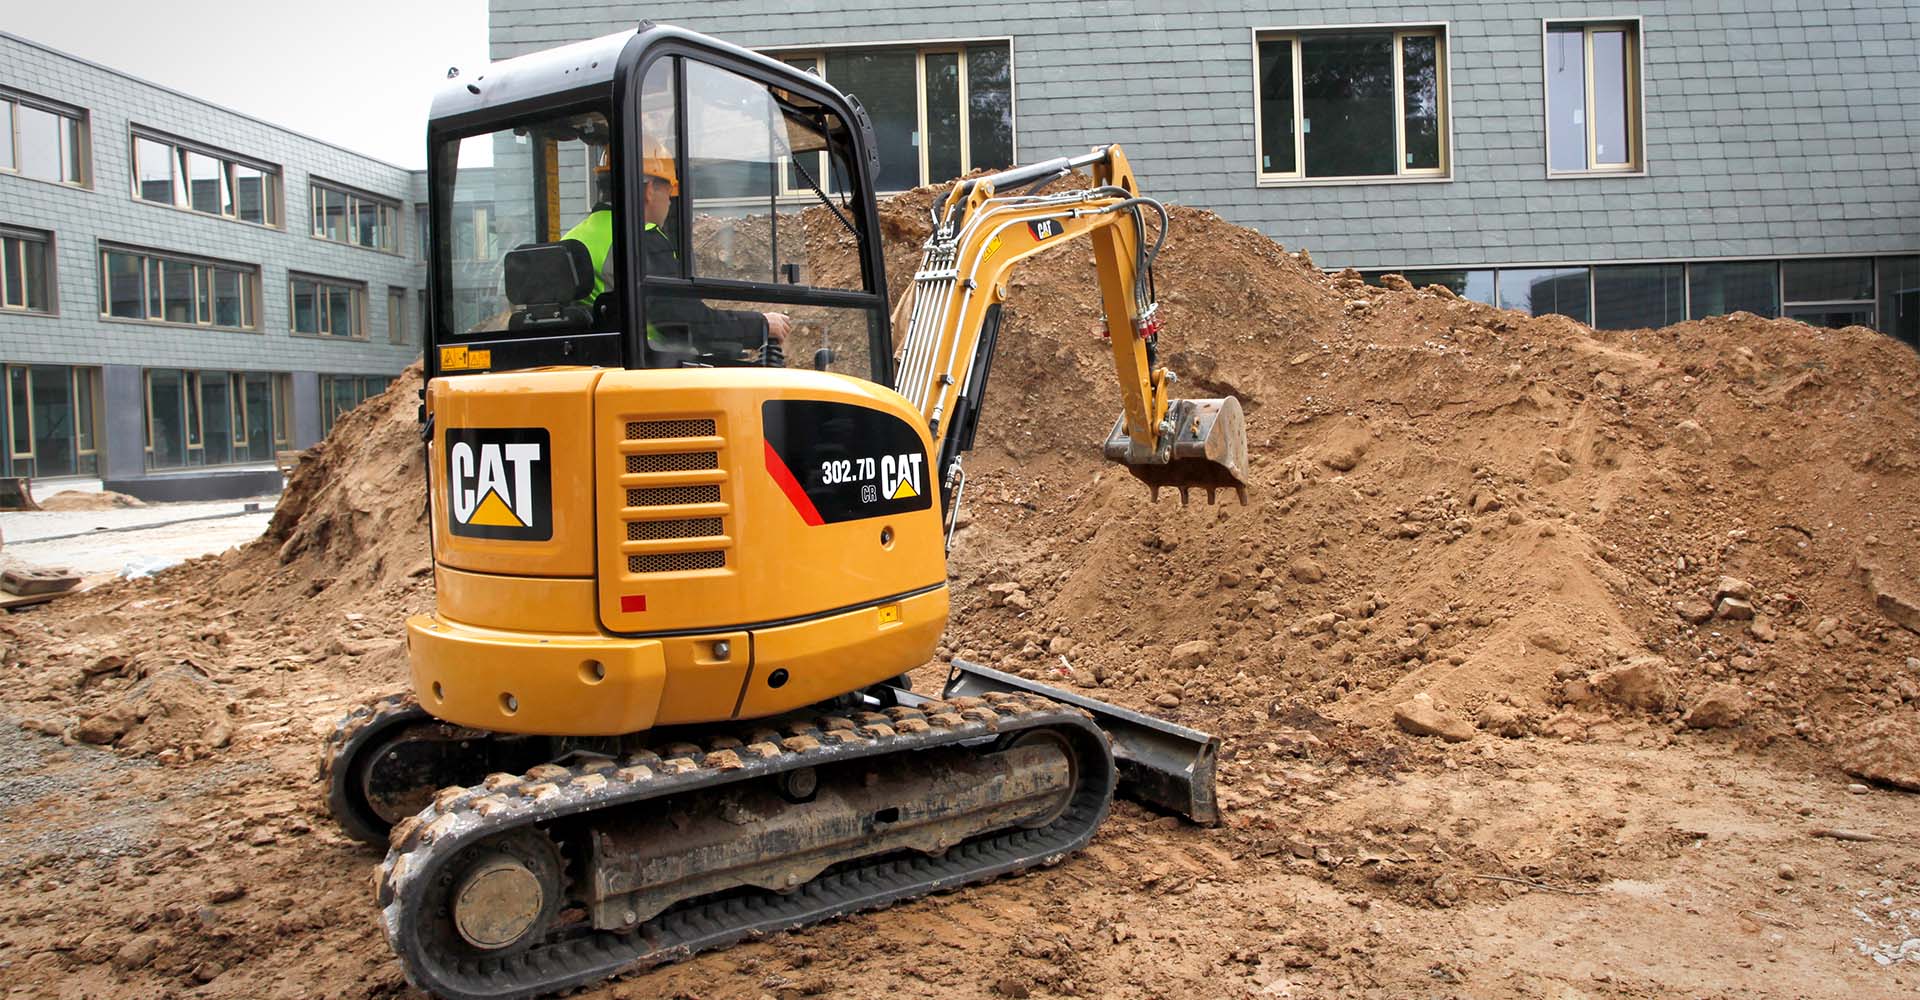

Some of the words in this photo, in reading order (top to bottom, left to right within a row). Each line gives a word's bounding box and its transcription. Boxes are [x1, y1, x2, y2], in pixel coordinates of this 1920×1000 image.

[1037, 220, 1052, 240] CAT
[452, 442, 540, 527] CAT
[821, 457, 876, 485] 302.7D
[881, 453, 922, 500] CAT
[861, 484, 878, 504] CR
